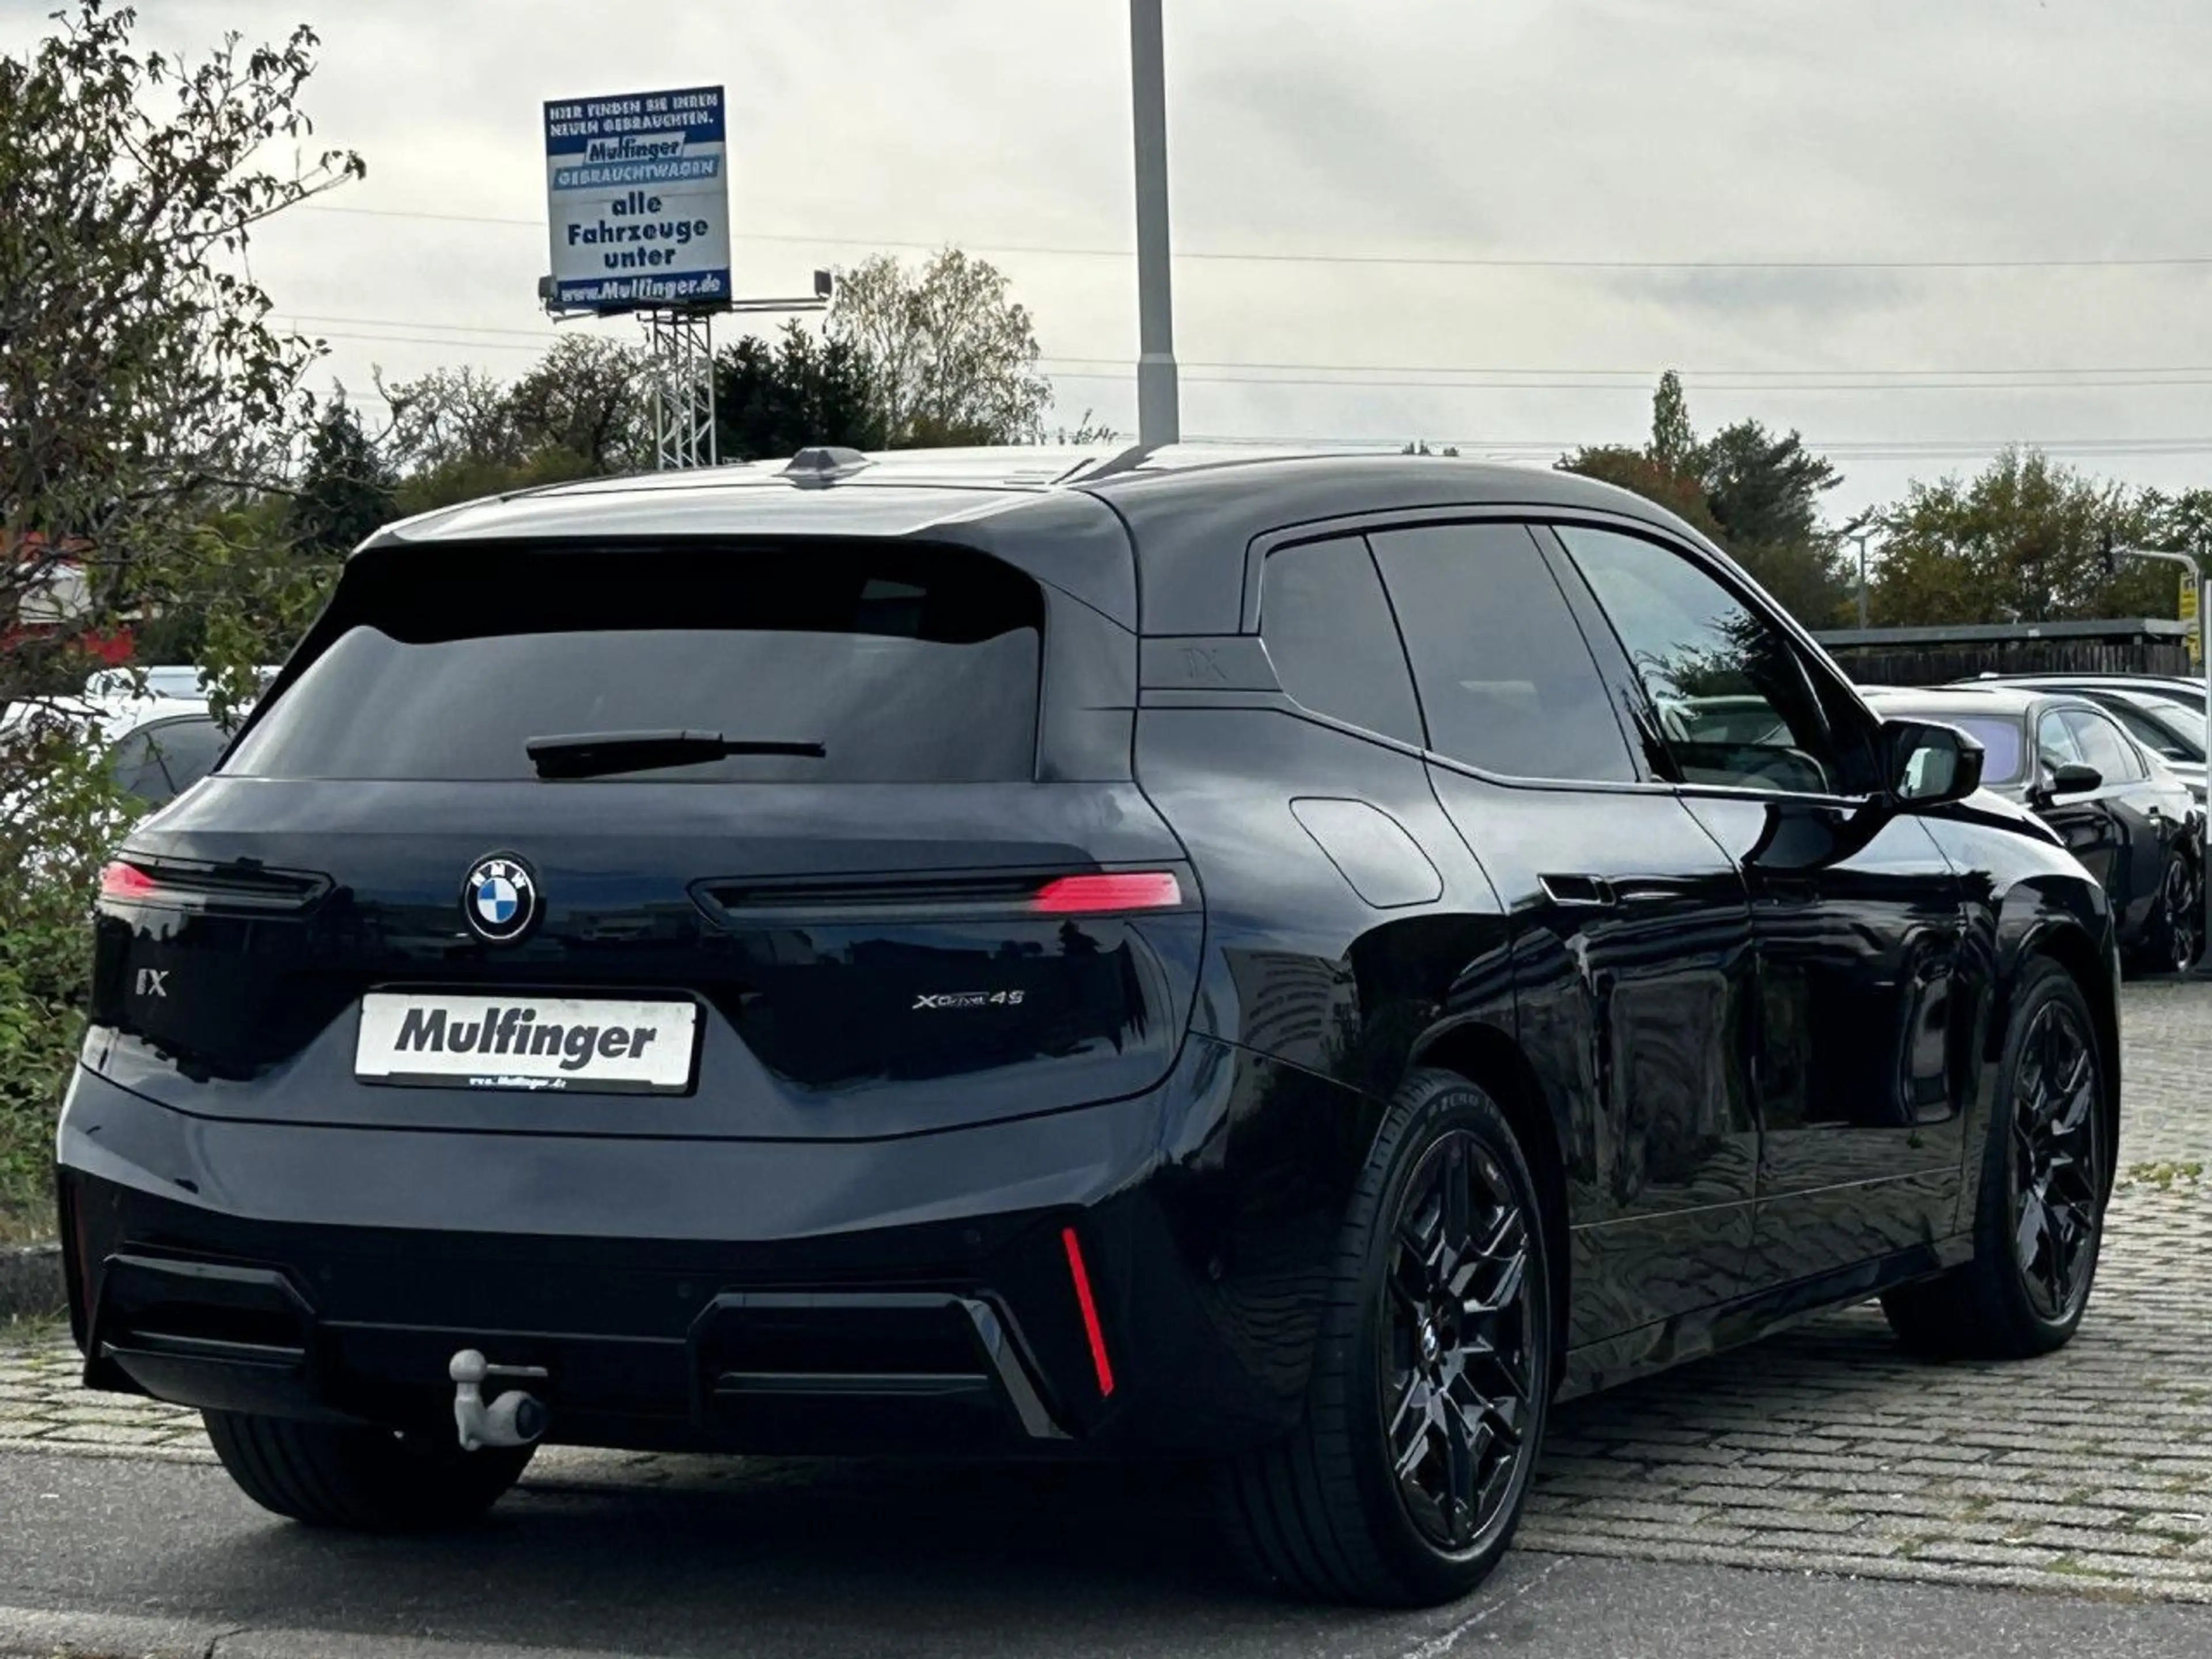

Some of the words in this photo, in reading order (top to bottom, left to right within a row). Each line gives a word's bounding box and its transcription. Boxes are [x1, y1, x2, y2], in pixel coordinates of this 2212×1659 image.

[589, 138, 679, 162] Mulfinger
[557, 160, 714, 185] GEBRAUCHTWAGEN
[612, 192, 662, 216] alle
[568, 218, 709, 246] Fahrzeuge
[604, 247, 676, 269] unter
[561, 274, 720, 301] www.Mulfinger.de
[470, 862, 527, 889] BMW
[394, 1007, 657, 1070] Mulfinger
